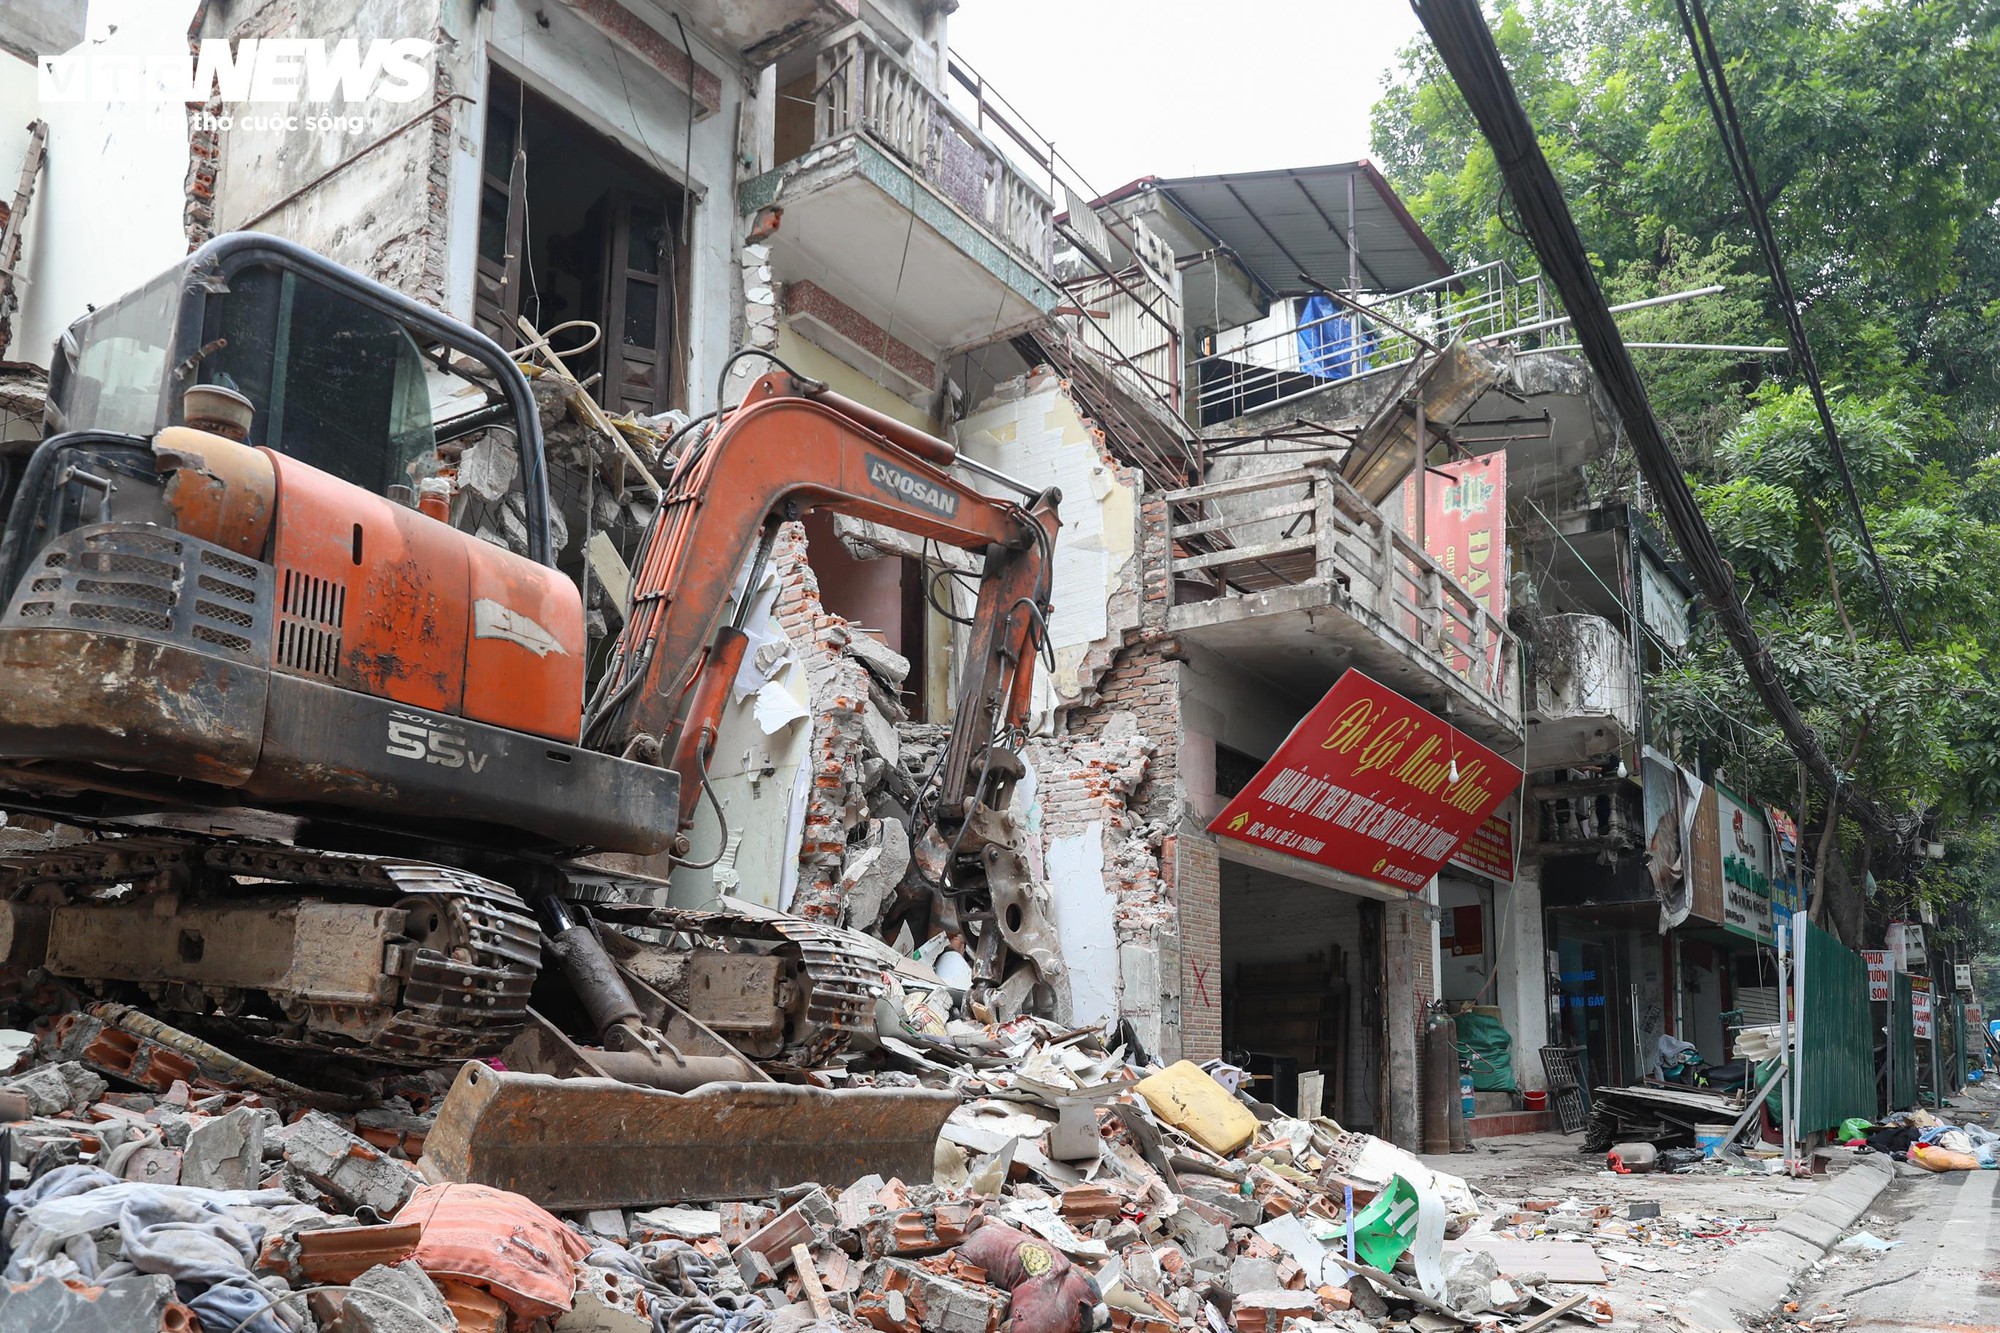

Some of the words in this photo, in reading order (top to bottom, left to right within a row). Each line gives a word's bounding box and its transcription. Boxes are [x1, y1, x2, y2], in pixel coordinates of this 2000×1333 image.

[870, 462, 955, 514] DOOSAN
[1319, 699, 1388, 755] Đồ
[1351, 715, 1422, 777] Gỗ
[1390, 733, 1462, 796] Minh
[1258, 766, 1310, 812] NHẬN
[1288, 773, 1330, 818] ĐẶT
[1308, 785, 1351, 822] THEO
[1440, 758, 1494, 815] Châu
[1332, 789, 1380, 830] THIẾT
[1355, 797, 1396, 835] KẾ
[1367, 802, 1411, 842] CHẤT
[1245, 821, 1265, 838] ĐC:
[1260, 826, 1281, 842] 841
[1287, 833, 1302, 849] LA
[1297, 836, 1325, 855] THÀNH
[1386, 813, 1423, 852] LIỆU
[1403, 815, 1440, 852] GỖ
[1412, 827, 1443, 860] TỰ
[1420, 830, 1459, 862] NHIÊN
